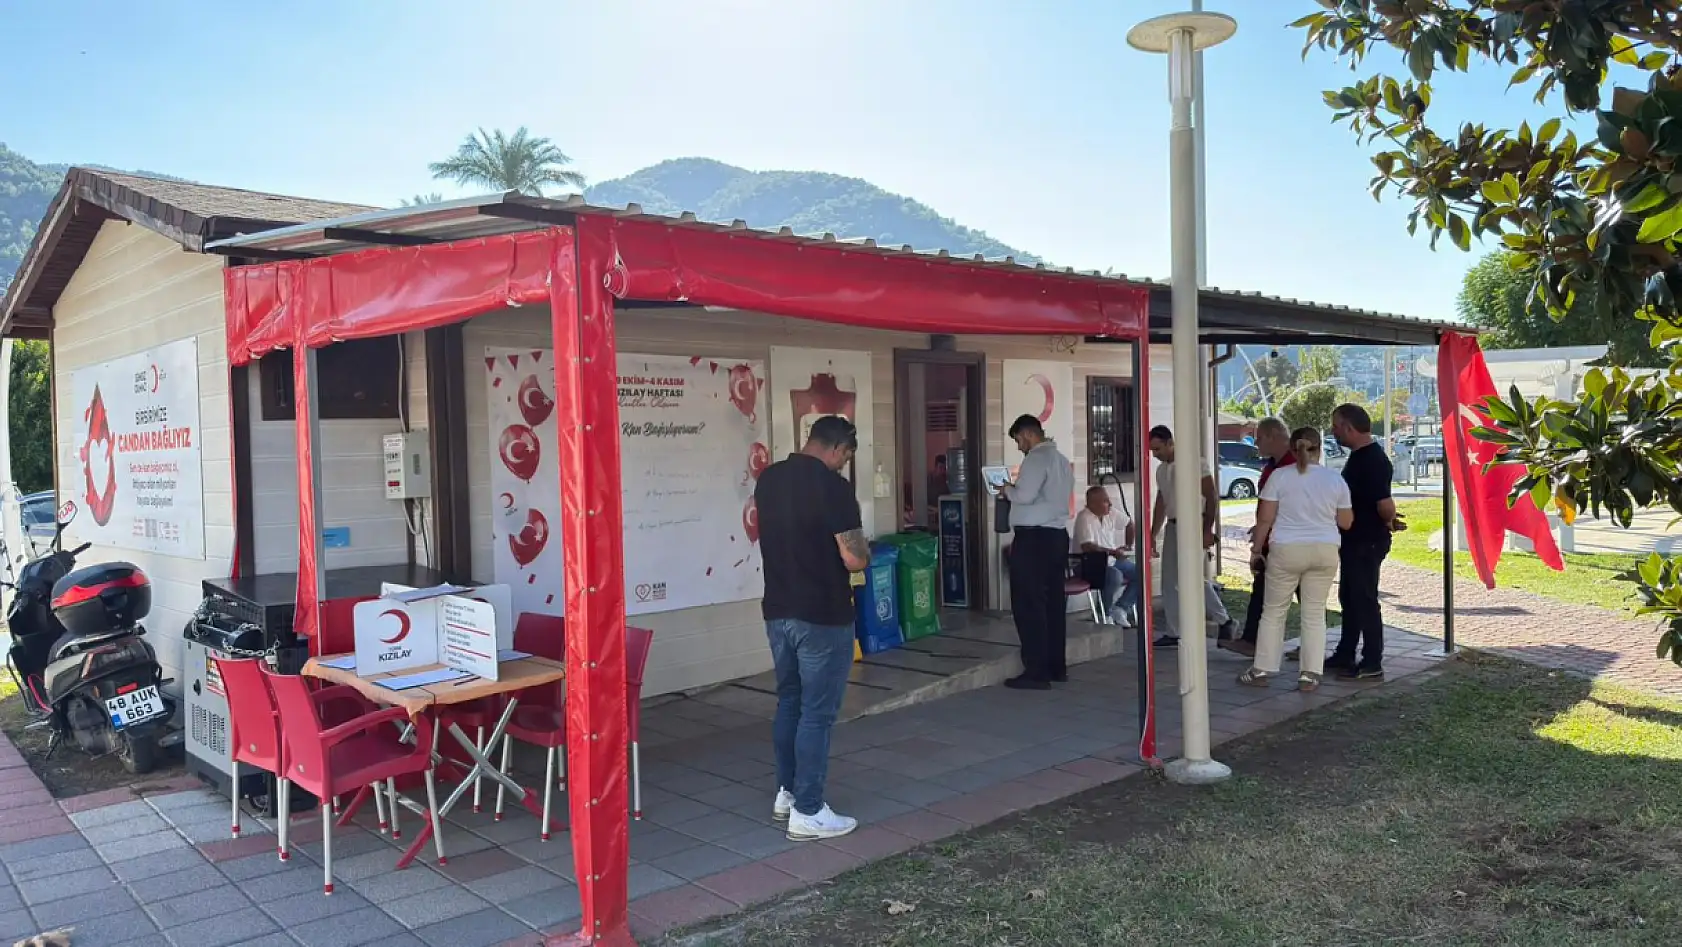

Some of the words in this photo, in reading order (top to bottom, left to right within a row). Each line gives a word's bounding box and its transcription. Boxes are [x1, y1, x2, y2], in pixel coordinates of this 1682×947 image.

[657, 377, 685, 386] KASIM
[616, 387, 646, 398] IZILAY
[647, 388, 683, 397] HAFTASI
[622, 422, 642, 437] Kan
[118, 431, 150, 453] CANDAN
[151, 424, 191, 450] BAĞLIYIZ
[378, 649, 412, 662] KIZILAY
[108, 697, 127, 711] 48
[131, 687, 157, 705] AUK
[126, 703, 153, 719] 663
